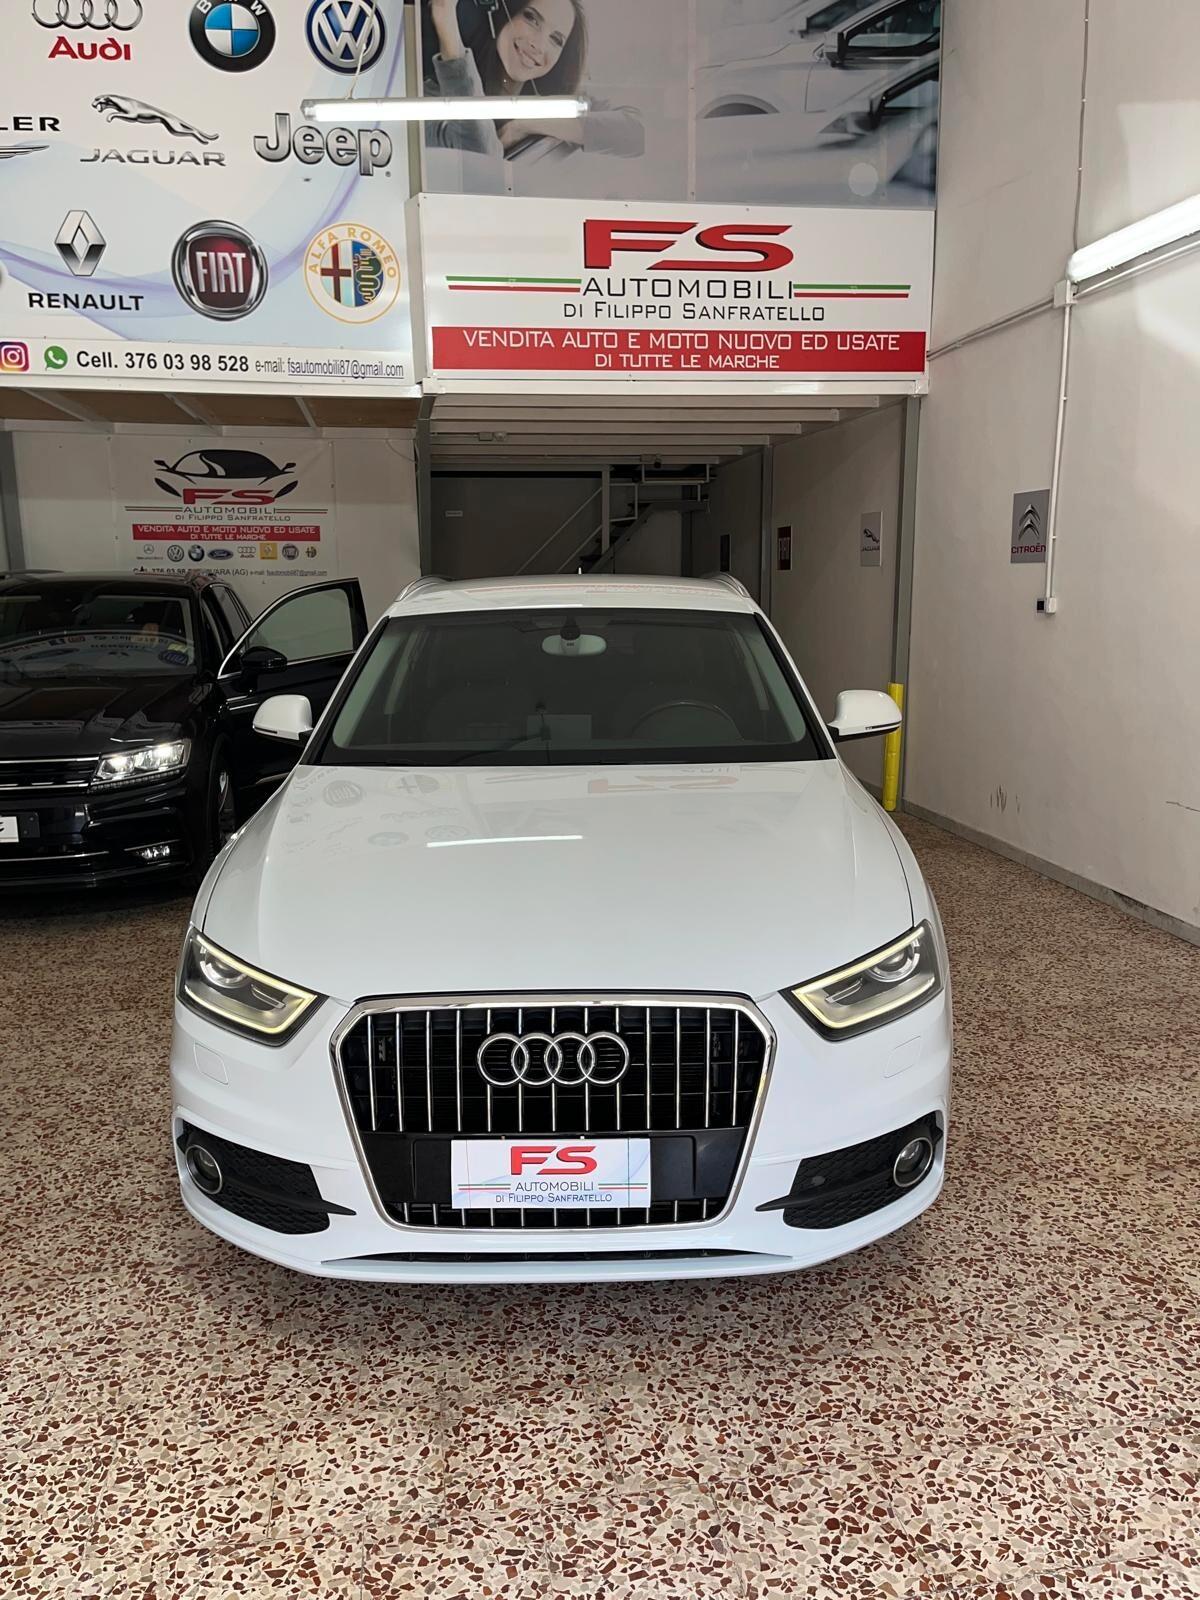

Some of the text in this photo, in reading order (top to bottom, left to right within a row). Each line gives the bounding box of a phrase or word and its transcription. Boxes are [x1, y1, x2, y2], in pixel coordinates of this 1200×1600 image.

[196, 0, 267, 16] BW
[48, 36, 131, 61] Audi
[253, 112, 393, 176] Jeep
[80, 148, 226, 167] JAGUAR
[309, 227, 397, 278] ALFA ROMEO
[584, 219, 794, 272] FS
[195, 251, 247, 294] FIAT
[583, 277, 793, 299] AUTOMOBILI
[28, 292, 144, 311] RENAULT
[563, 302, 825, 321] DI FILIPPO SANFRATELLO
[463, 330, 900, 351] VENDITA AUTO E MOTO NUOVO ED USATE
[76, 350, 118, 368] Cell.
[124, 352, 157, 369] 376
[163, 353, 184, 370] 03
[190, 354, 211, 371] 98
[218, 355, 249, 372] 528
[595, 353, 780, 369] DI TUTTE LE MARCHE
[183, 488, 276, 505] FS
[183, 506, 276, 514] AUTOMOBILI
[138, 525, 175, 533] VENDITA
[274, 526, 285, 534] ED
[510, 1145, 598, 1175] FS
[515, 1181, 594, 1192] AUTOMOBILI
[496, 1192, 613, 1203] DI FILIPPO SANFRATELLO
